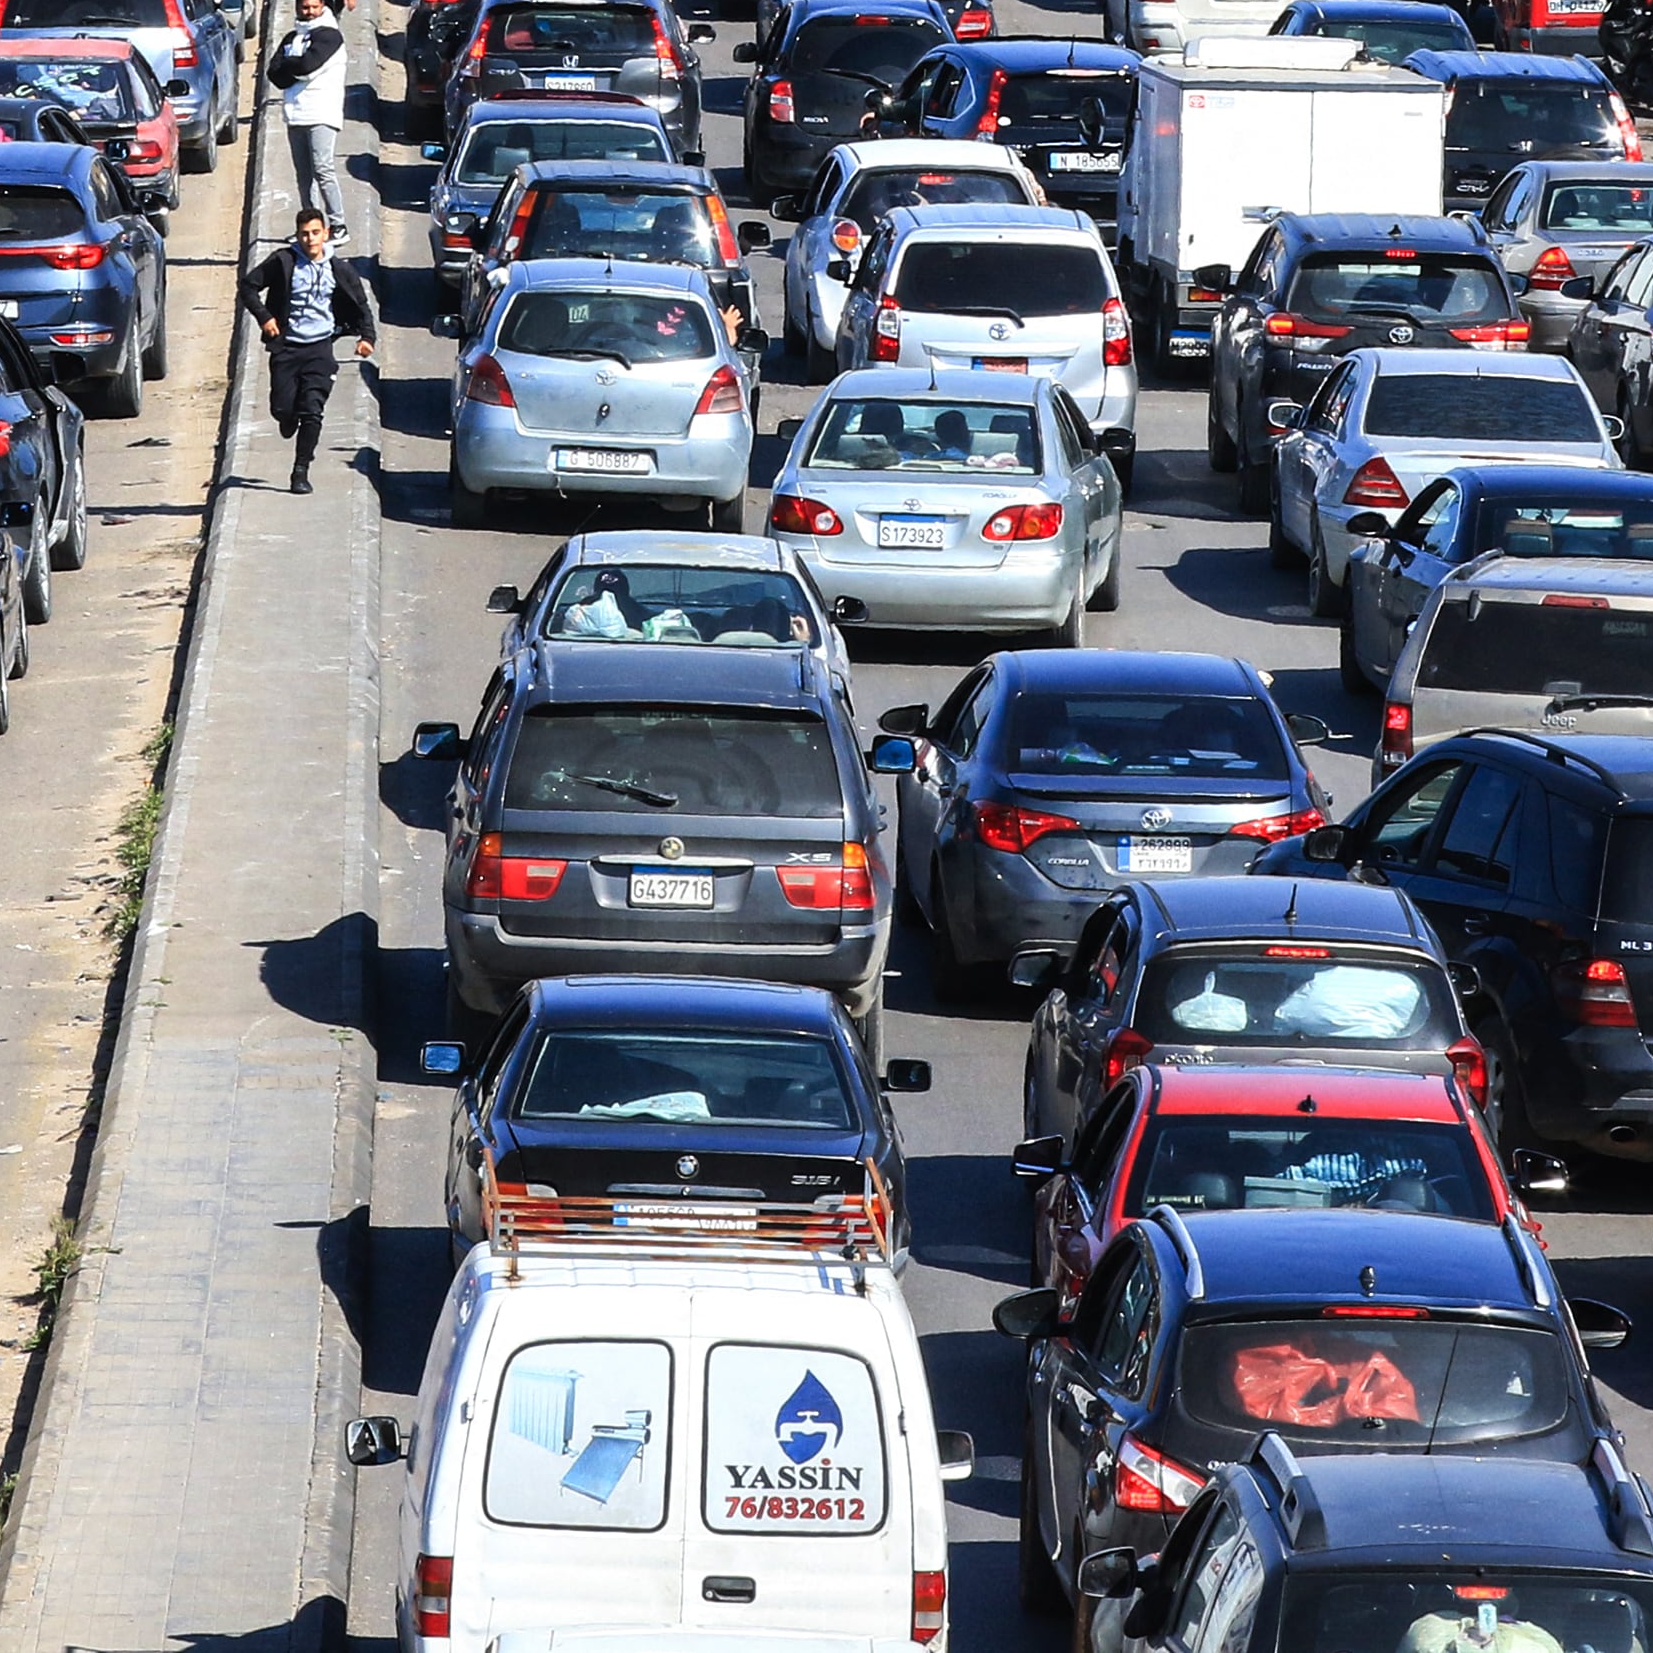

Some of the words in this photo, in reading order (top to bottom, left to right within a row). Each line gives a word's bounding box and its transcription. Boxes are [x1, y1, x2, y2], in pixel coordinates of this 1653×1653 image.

[881, 526, 944, 544] S173923
[1540, 713, 1577, 730] Jeep
[633, 878, 712, 900] G437716
[1620, 941, 1641, 951] ML
[725, 1495, 865, 1521] 76/832612
